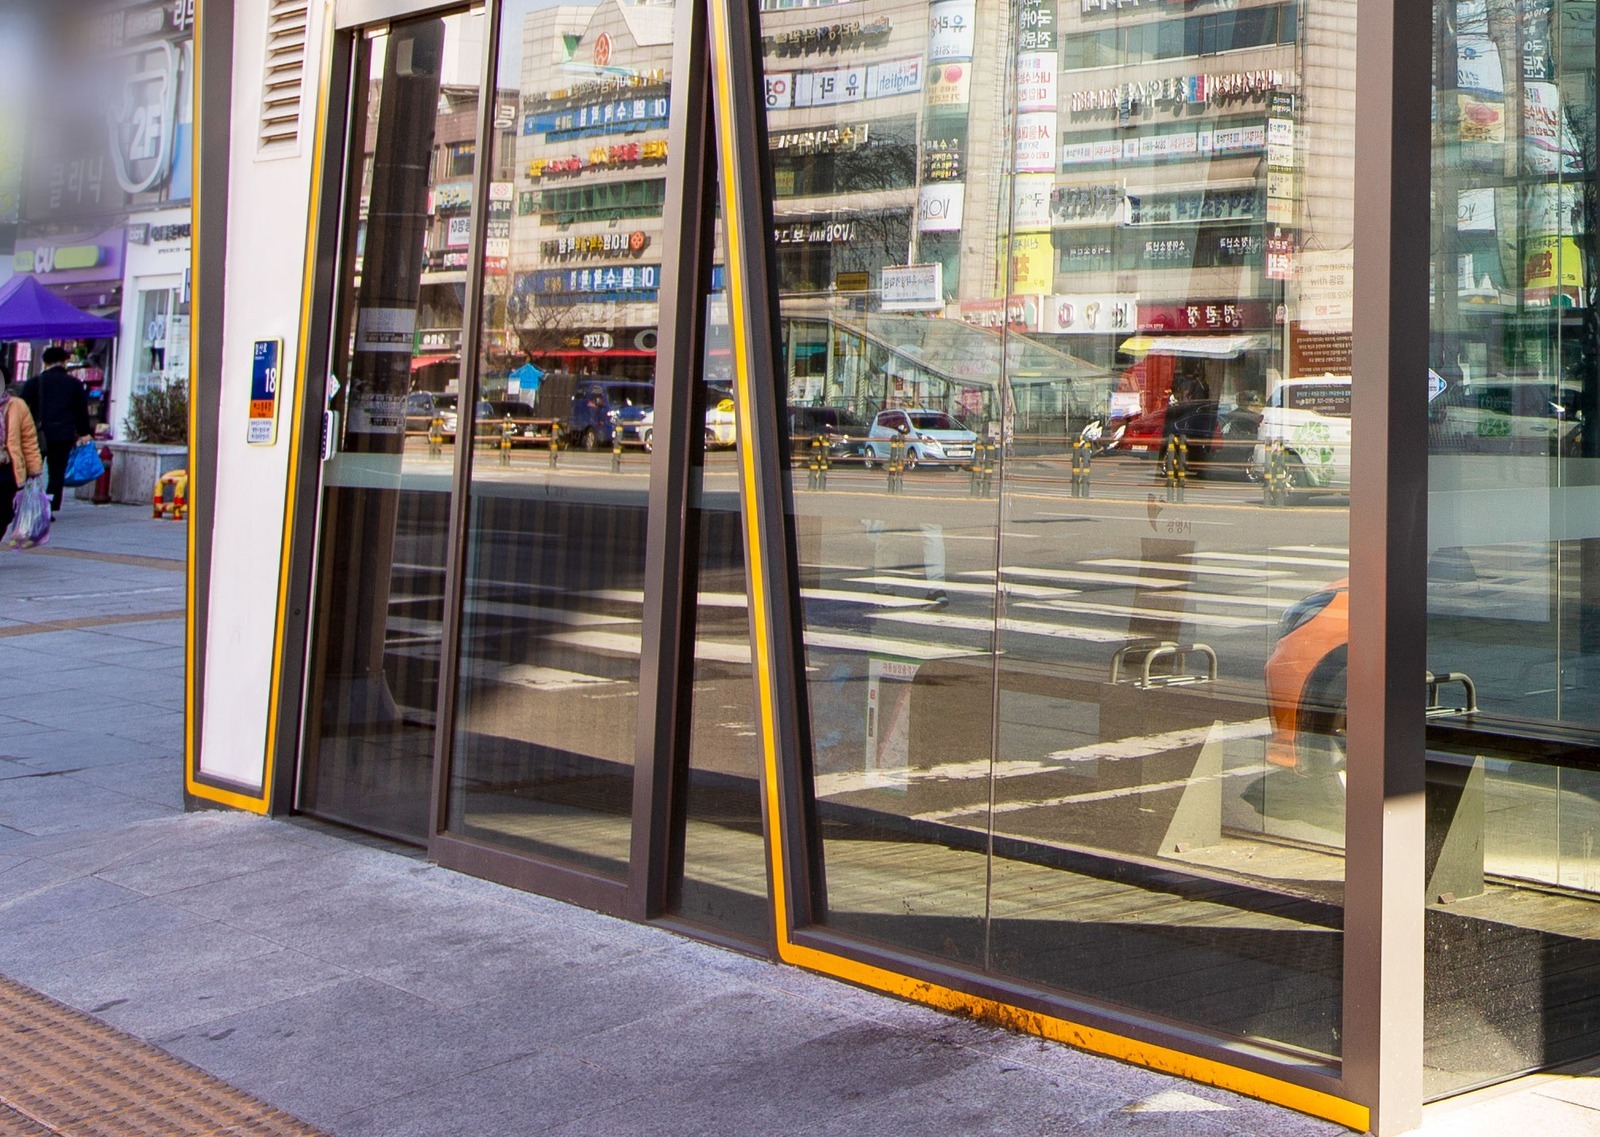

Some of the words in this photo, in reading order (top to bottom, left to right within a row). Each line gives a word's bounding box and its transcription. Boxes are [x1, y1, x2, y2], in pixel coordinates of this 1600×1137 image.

[130, 106, 163, 161] 2F
[34, 247, 56, 274] CU
[265, 367, 277, 393] 18
